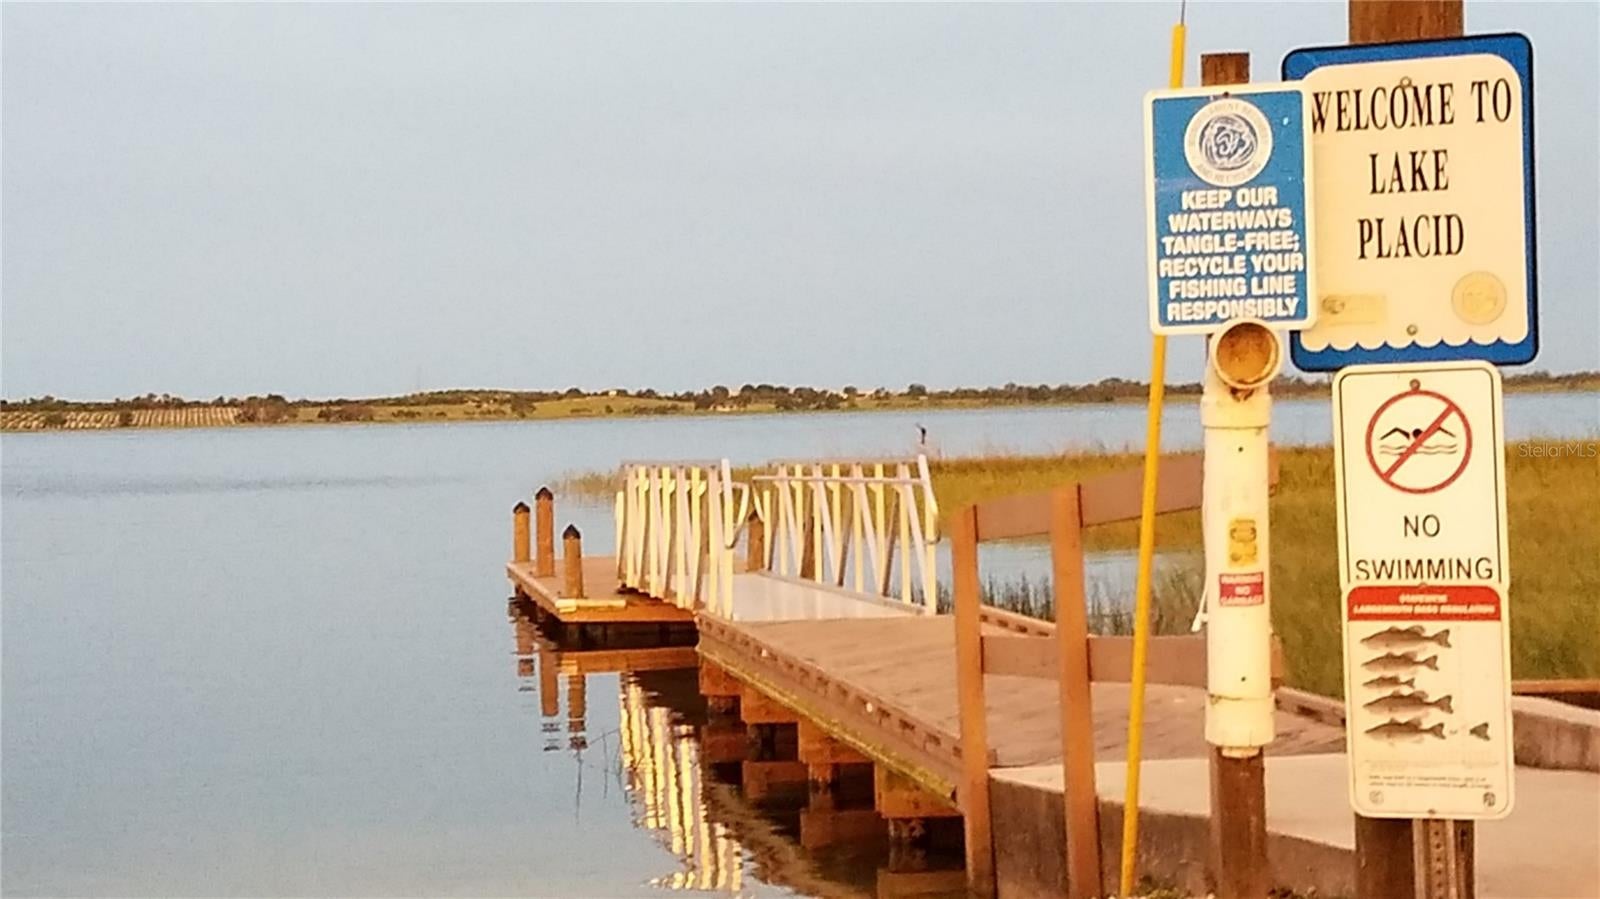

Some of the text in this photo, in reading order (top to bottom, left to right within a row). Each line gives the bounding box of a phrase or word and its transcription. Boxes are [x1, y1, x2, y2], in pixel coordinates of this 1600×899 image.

[1312, 83, 1455, 134] WELCOME
[1471, 78, 1512, 123] TO
[1369, 149, 1449, 195] LAKE
[1181, 186, 1278, 210] KEEP OUR
[1168, 208, 1293, 233] WATERWAYS
[1161, 230, 1300, 255] TANGLE-FREE;
[1358, 213, 1464, 260] PLACID
[1159, 252, 1304, 278] RECYCLE YOUR
[1169, 275, 1296, 299] FISHING LINE
[1167, 297, 1299, 321] RESPONSIBLY
[1404, 514, 1440, 538] NO
[1355, 557, 1493, 581] SWIMMING
